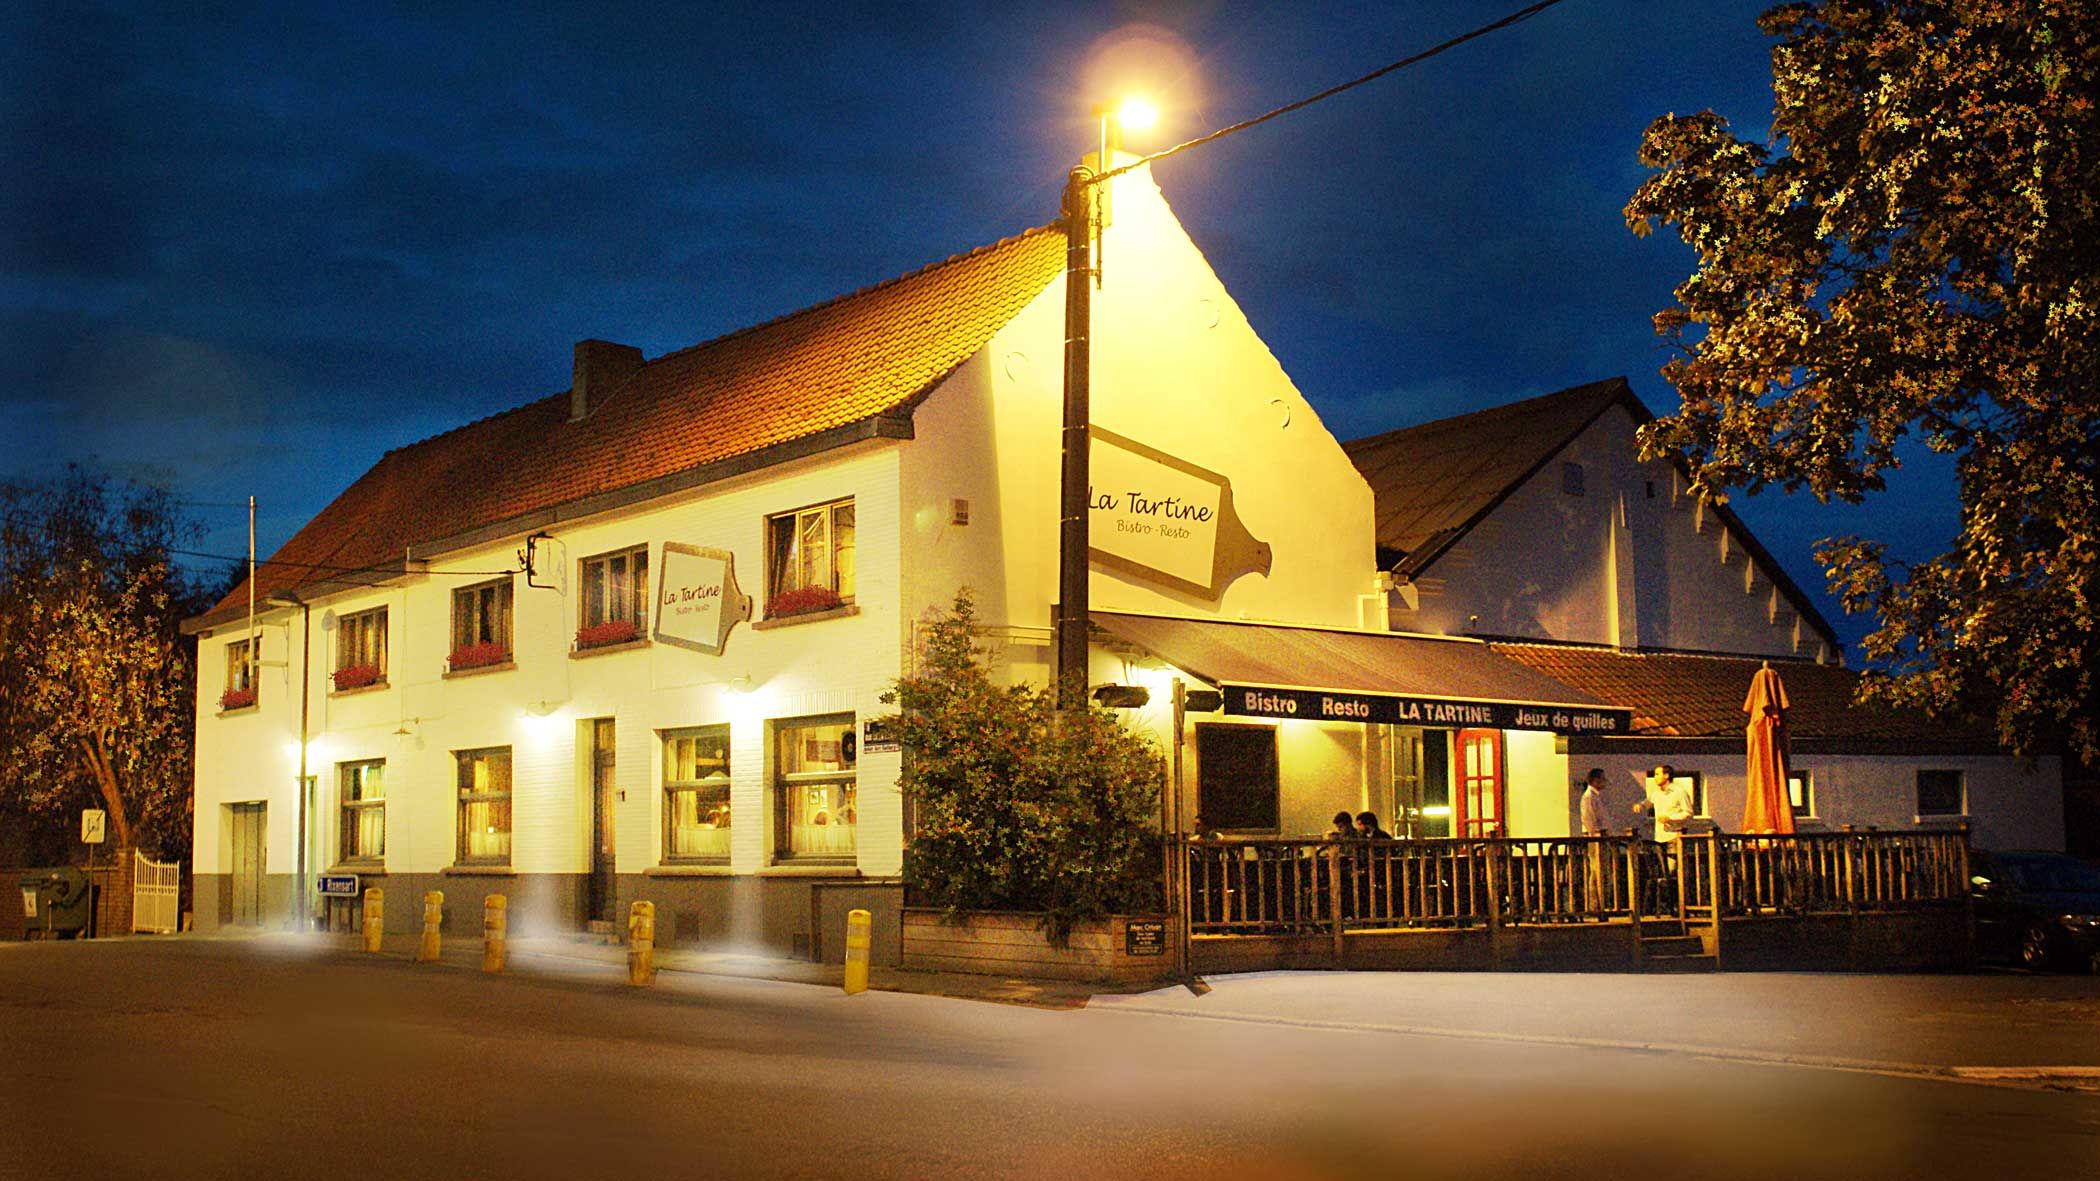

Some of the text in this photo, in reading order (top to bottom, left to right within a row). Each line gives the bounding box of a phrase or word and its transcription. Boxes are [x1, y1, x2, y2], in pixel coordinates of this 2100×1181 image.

[1088, 486, 1214, 522] La Tartine
[1116, 519, 1152, 535] Bistro
[663, 584, 721, 605] La Tartine
[1245, 692, 1616, 731] Bistro Resto LA TARTINE Jeux de quilles
